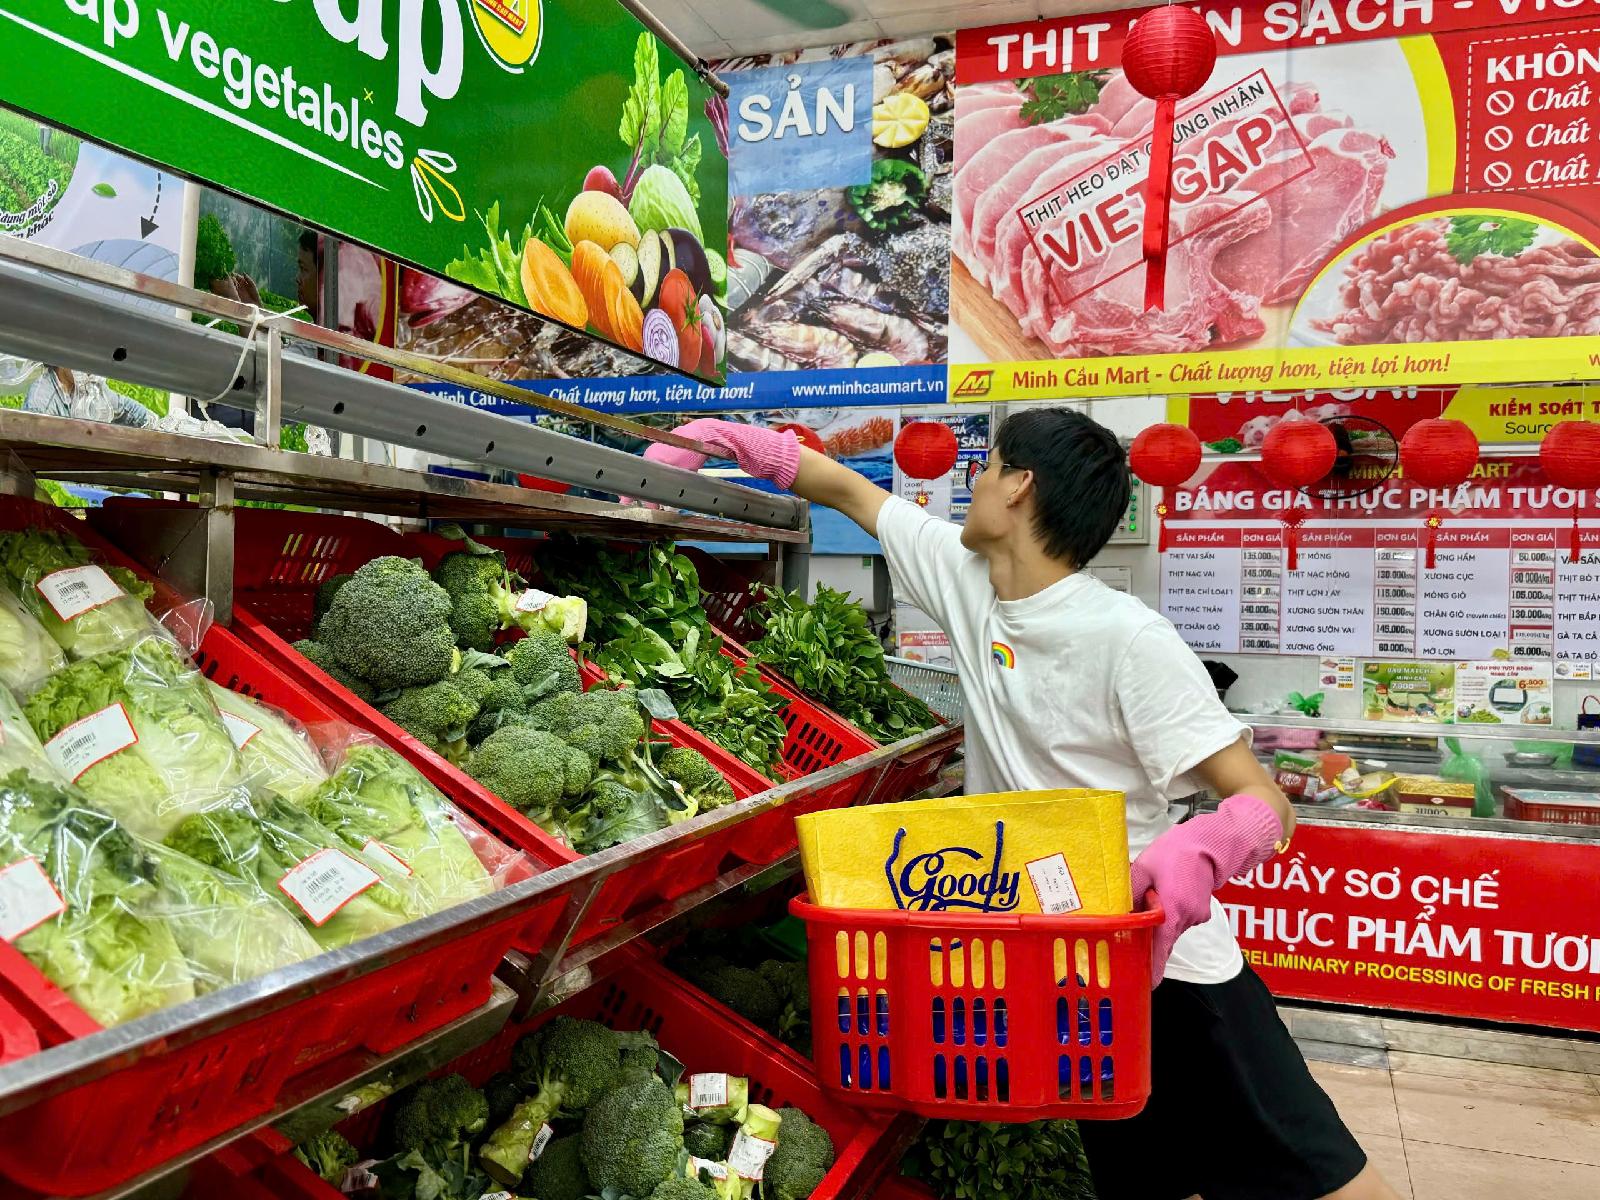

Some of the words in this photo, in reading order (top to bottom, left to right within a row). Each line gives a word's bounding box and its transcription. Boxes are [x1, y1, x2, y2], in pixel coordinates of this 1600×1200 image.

[987, 23, 1111, 73] THỊT
[1262, 0, 1433, 44] SẠCH
[156, 9, 404, 169] vegetables
[1527, 80, 1592, 112] Chất
[738, 73, 856, 142] SẢN
[1526, 117, 1591, 148] Chất
[1024, 195, 1062, 227] THỊT
[1067, 173, 1104, 204] HEO
[1106, 151, 1140, 181] ĐẠT
[1145, 113, 1209, 157] CNG
[1211, 81, 1264, 120] NHẬN
[1525, 153, 1590, 184] Chất
[1012, 371, 1057, 389] Minh
[1064, 365, 1098, 388] Cầu
[1105, 366, 1149, 386] Mart
[1169, 360, 1212, 383] Chất
[1217, 361, 1274, 384] lượng
[1279, 359, 1321, 380] hơn,
[1328, 357, 1364, 378] tiện
[1371, 355, 1398, 376] lợi
[1404, 353, 1451, 374] hơn!
[584, 386, 626, 408] lượng
[629, 386, 660, 405] hơn,
[665, 383, 692, 404] tiện
[792, 379, 944, 397] www.minhcaumart.vn
[1489, 397, 1532, 417] KIỂM
[1539, 398, 1584, 416] SOÁT
[1505, 422, 1553, 435] Sourc
[961, 434, 985, 448] SẢN
[1466, 463, 1514, 479] ART
[1175, 485, 1255, 512] BẢNG
[1262, 486, 1312, 511] GIÁ
[1409, 481, 1501, 510] PHẨM
[1507, 484, 1586, 510] TƯƠI
[1176, 532, 1195, 542] SẢN
[1197, 532, 1225, 542] PHẨM
[1243, 534, 1263, 542] ĐƠN
[1265, 533, 1281, 542] GIÁ
[1302, 532, 1321, 542] SẢN
[1325, 532, 1352, 542] PHẨM
[1400, 533, 1417, 541] GIÁ
[1436, 533, 1457, 542] SẢN
[1460, 532, 1489, 542] PHẨM
[1511, 534, 1534, 542] ĐƠN
[1536, 533, 1554, 542] GIÁ
[1169, 553, 1185, 561] THỊT
[1288, 571, 1304, 580] THỊT
[1558, 574, 1578, 583] THỊT
[1288, 589, 1305, 597] THỊT
[1558, 593, 1577, 602] THỊT
[1167, 605, 1184, 613] THỊT
[1558, 613, 1577, 622] THỊT
[900, 847, 1020, 910] Goody
[1343, 866, 1400, 899] SƠ
[1410, 869, 1500, 909] CHẾ
[1222, 902, 1335, 952] THỰC
[1347, 905, 1482, 962] PHẨM
[1494, 929, 1600, 974] TƯƠI
[1240, 948, 1349, 976] RELIMINARY
[1354, 962, 1484, 989] PROCESSING
[1488, 975, 1517, 992] OF
[1521, 978, 1589, 1000] FRESH
